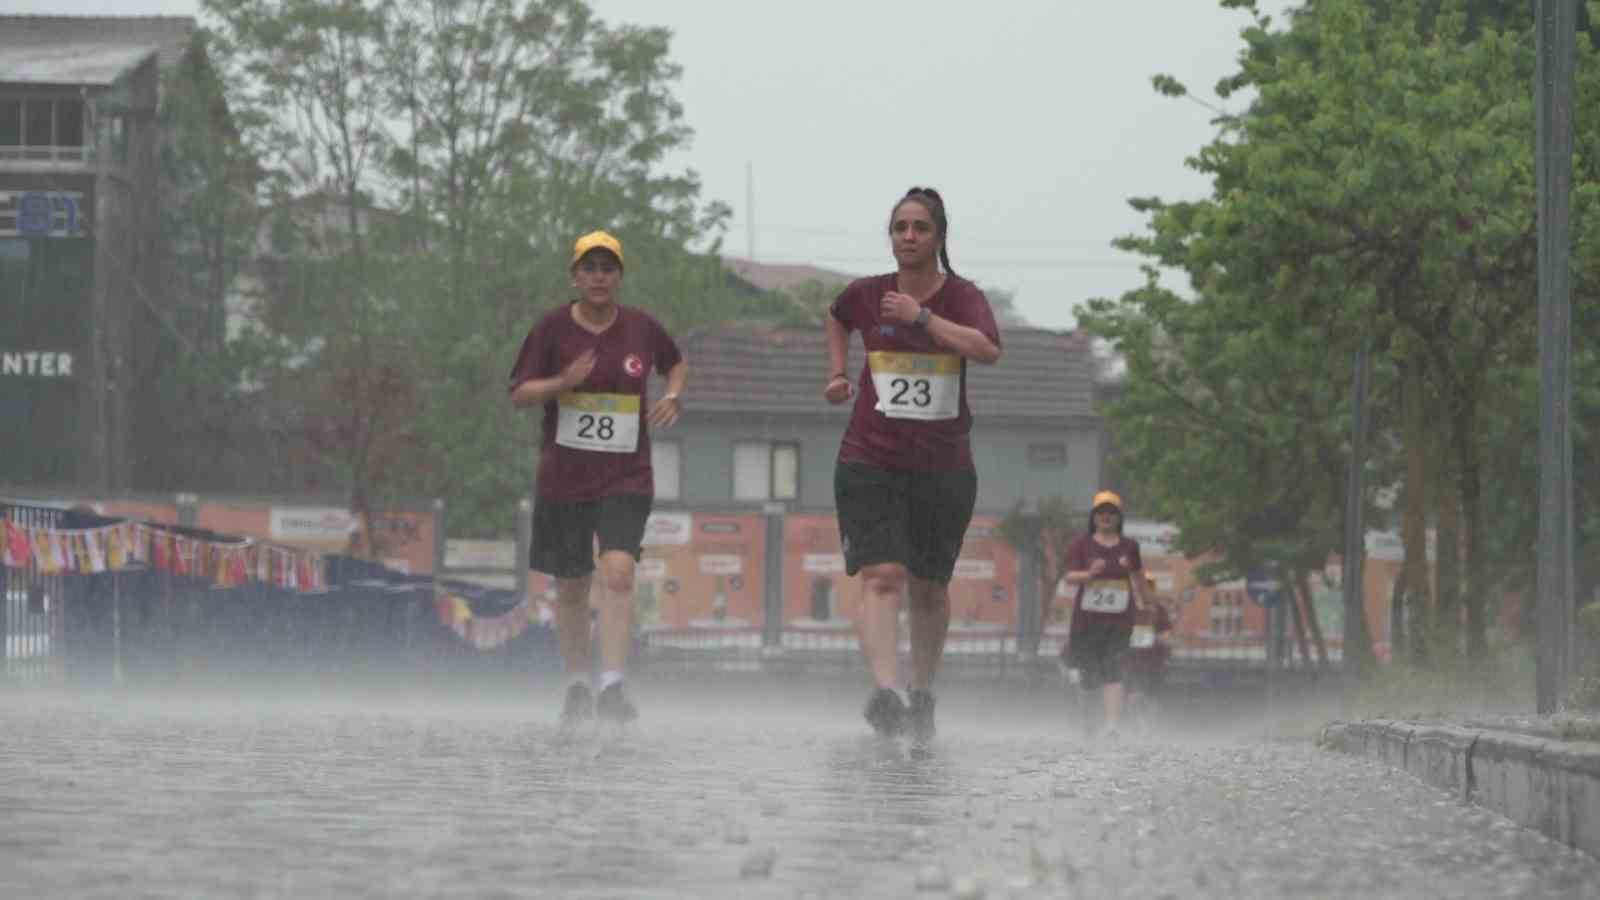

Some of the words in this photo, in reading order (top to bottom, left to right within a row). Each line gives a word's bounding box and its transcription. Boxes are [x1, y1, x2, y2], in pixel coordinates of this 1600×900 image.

[890, 378, 931, 408] 23
[577, 414, 614, 440] 28
[1093, 592, 1115, 606] 24
